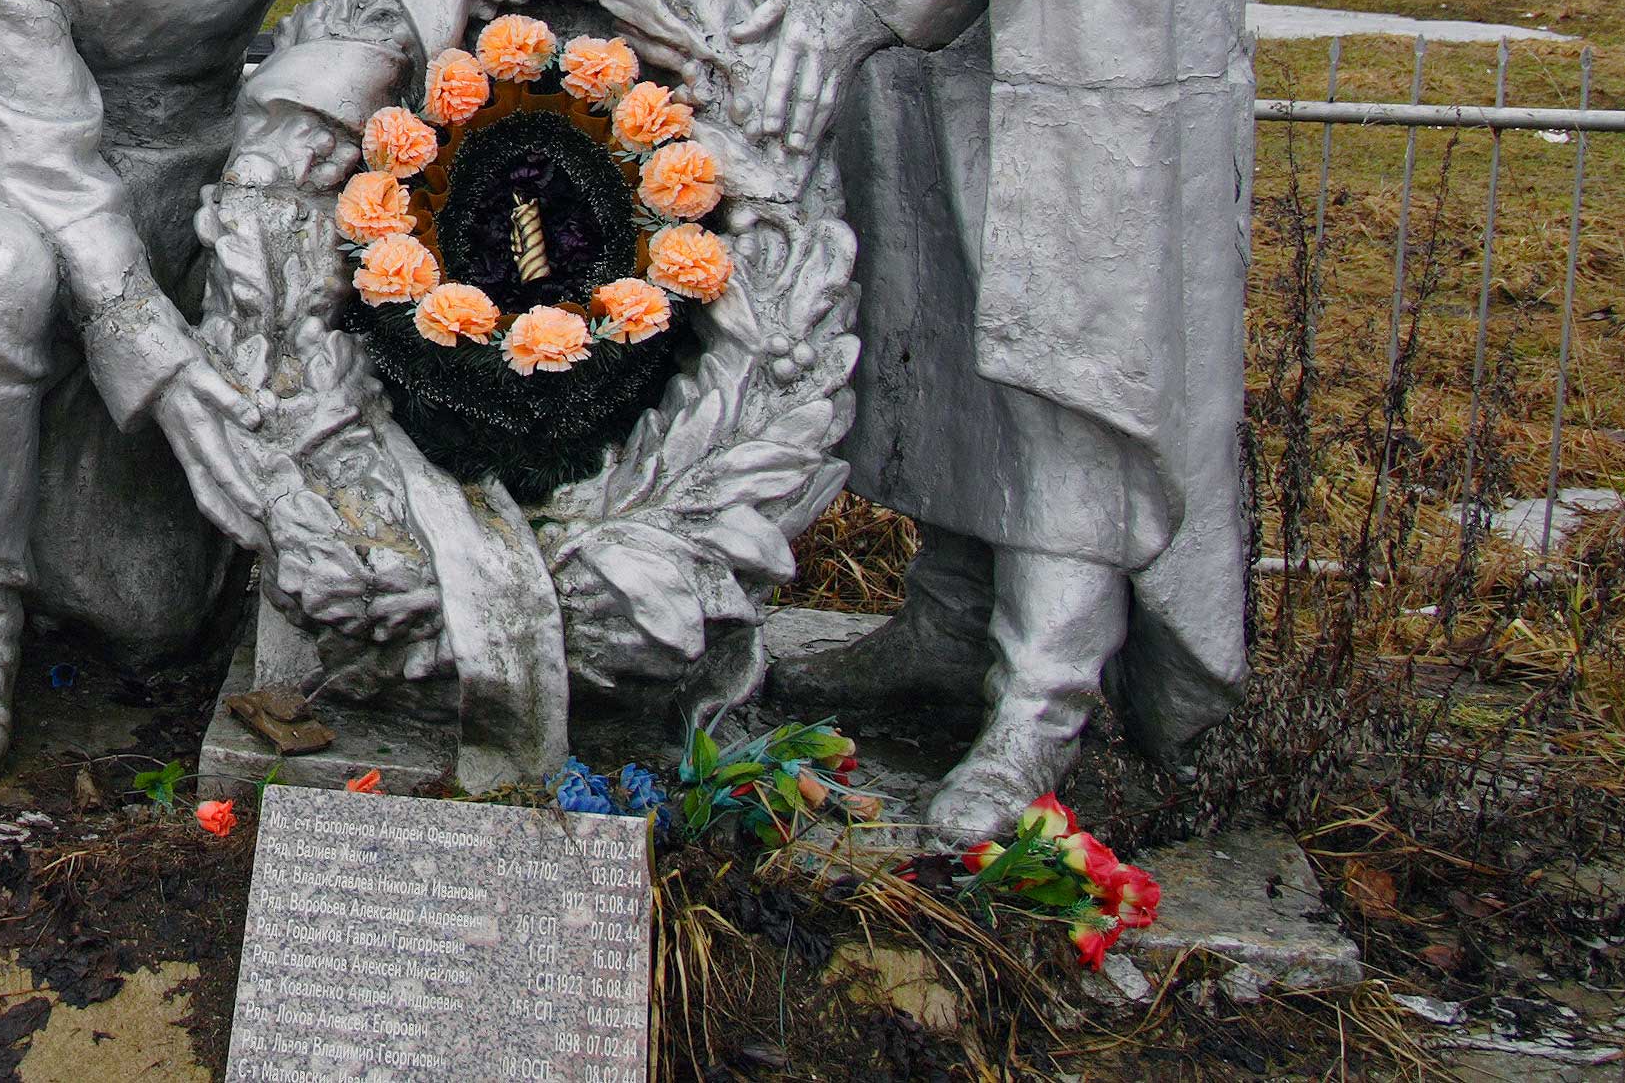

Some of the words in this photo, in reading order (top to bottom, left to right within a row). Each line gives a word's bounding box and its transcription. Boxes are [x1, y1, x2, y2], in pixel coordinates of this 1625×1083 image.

[266, 836, 291, 857] Ряд.
[296, 839, 337, 860] Валиев
[341, 843, 378, 863] Хаким
[497, 858, 522, 878] В/ч
[592, 866, 641, 888] 03.02.44
[379, 821, 423, 843] Андрей
[427, 825, 493, 848] Федорович
[593, 840, 641, 860] 07.02.44
[263, 862, 288, 883] Ряд.
[377, 873, 428, 896] Николай
[432, 877, 488, 902] Иванович
[562, 891, 584, 910] 1912
[594, 893, 639, 915] 15.08.41
[260, 889, 284, 910] Ряд.
[289, 892, 346, 917] Воробьев
[350, 899, 414, 926] Александр
[418, 906, 483, 930] Андреевич
[538, 917, 556, 936] СП
[591, 921, 640, 943] 07.02.44
[256, 916, 281, 938] Ряд.
[286, 919, 342, 943] Гордиков
[346, 926, 387, 950] Гаврил
[391, 931, 465, 955] Григорьевич
[537, 944, 556, 964] СП
[592, 949, 639, 971] 16.08.41
[252, 944, 278, 966] Ряд.
[282, 947, 347, 971] Евдокимов
[351, 954, 402, 977] Алексей
[535, 972, 554, 993] СП
[591, 977, 638, 1000] 16.08.41
[279, 976, 344, 1000] Коваленко
[348, 984, 393, 1006] Андрей
[534, 1001, 553, 1022] СП
[587, 1006, 639, 1029] 04.02.44
[272, 1032, 308, 1055] Львов
[312, 1036, 374, 1062] Владимир
[521, 1058, 550, 1081] ОСП
[317, 1010, 368, 1032] Алексей
[373, 1015, 428, 1039] Егорович
[554, 1032, 580, 1052] 1898
[587, 1035, 638, 1058] 07.02.44
